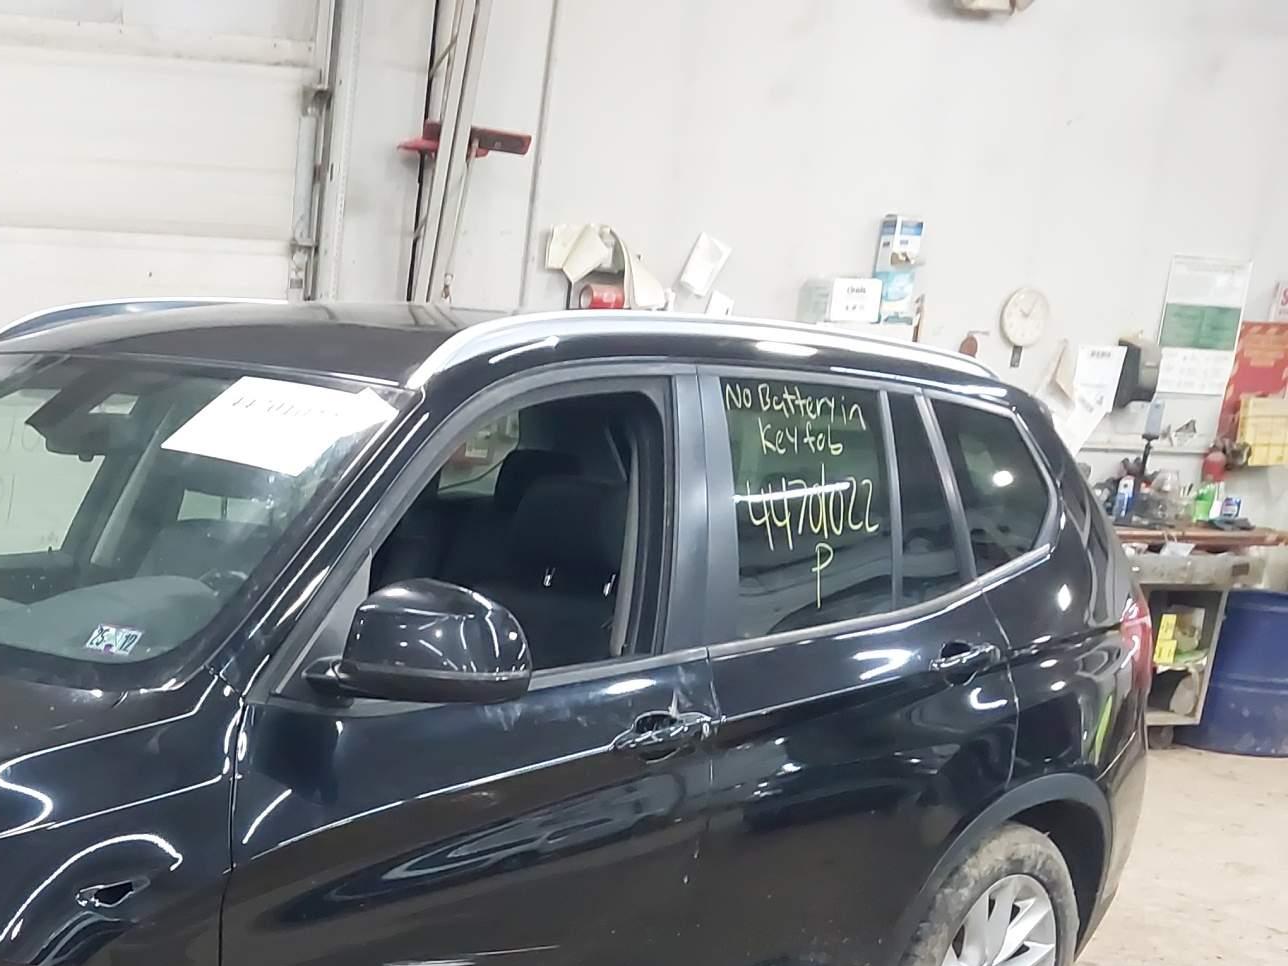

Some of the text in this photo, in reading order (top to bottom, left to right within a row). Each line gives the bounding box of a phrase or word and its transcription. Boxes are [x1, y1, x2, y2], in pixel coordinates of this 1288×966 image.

[725, 383, 752, 411] No
[841, 395, 867, 431] in
[758, 417, 844, 456] Key fob
[746, 463, 880, 551] 44701022
[811, 542, 834, 609] P
